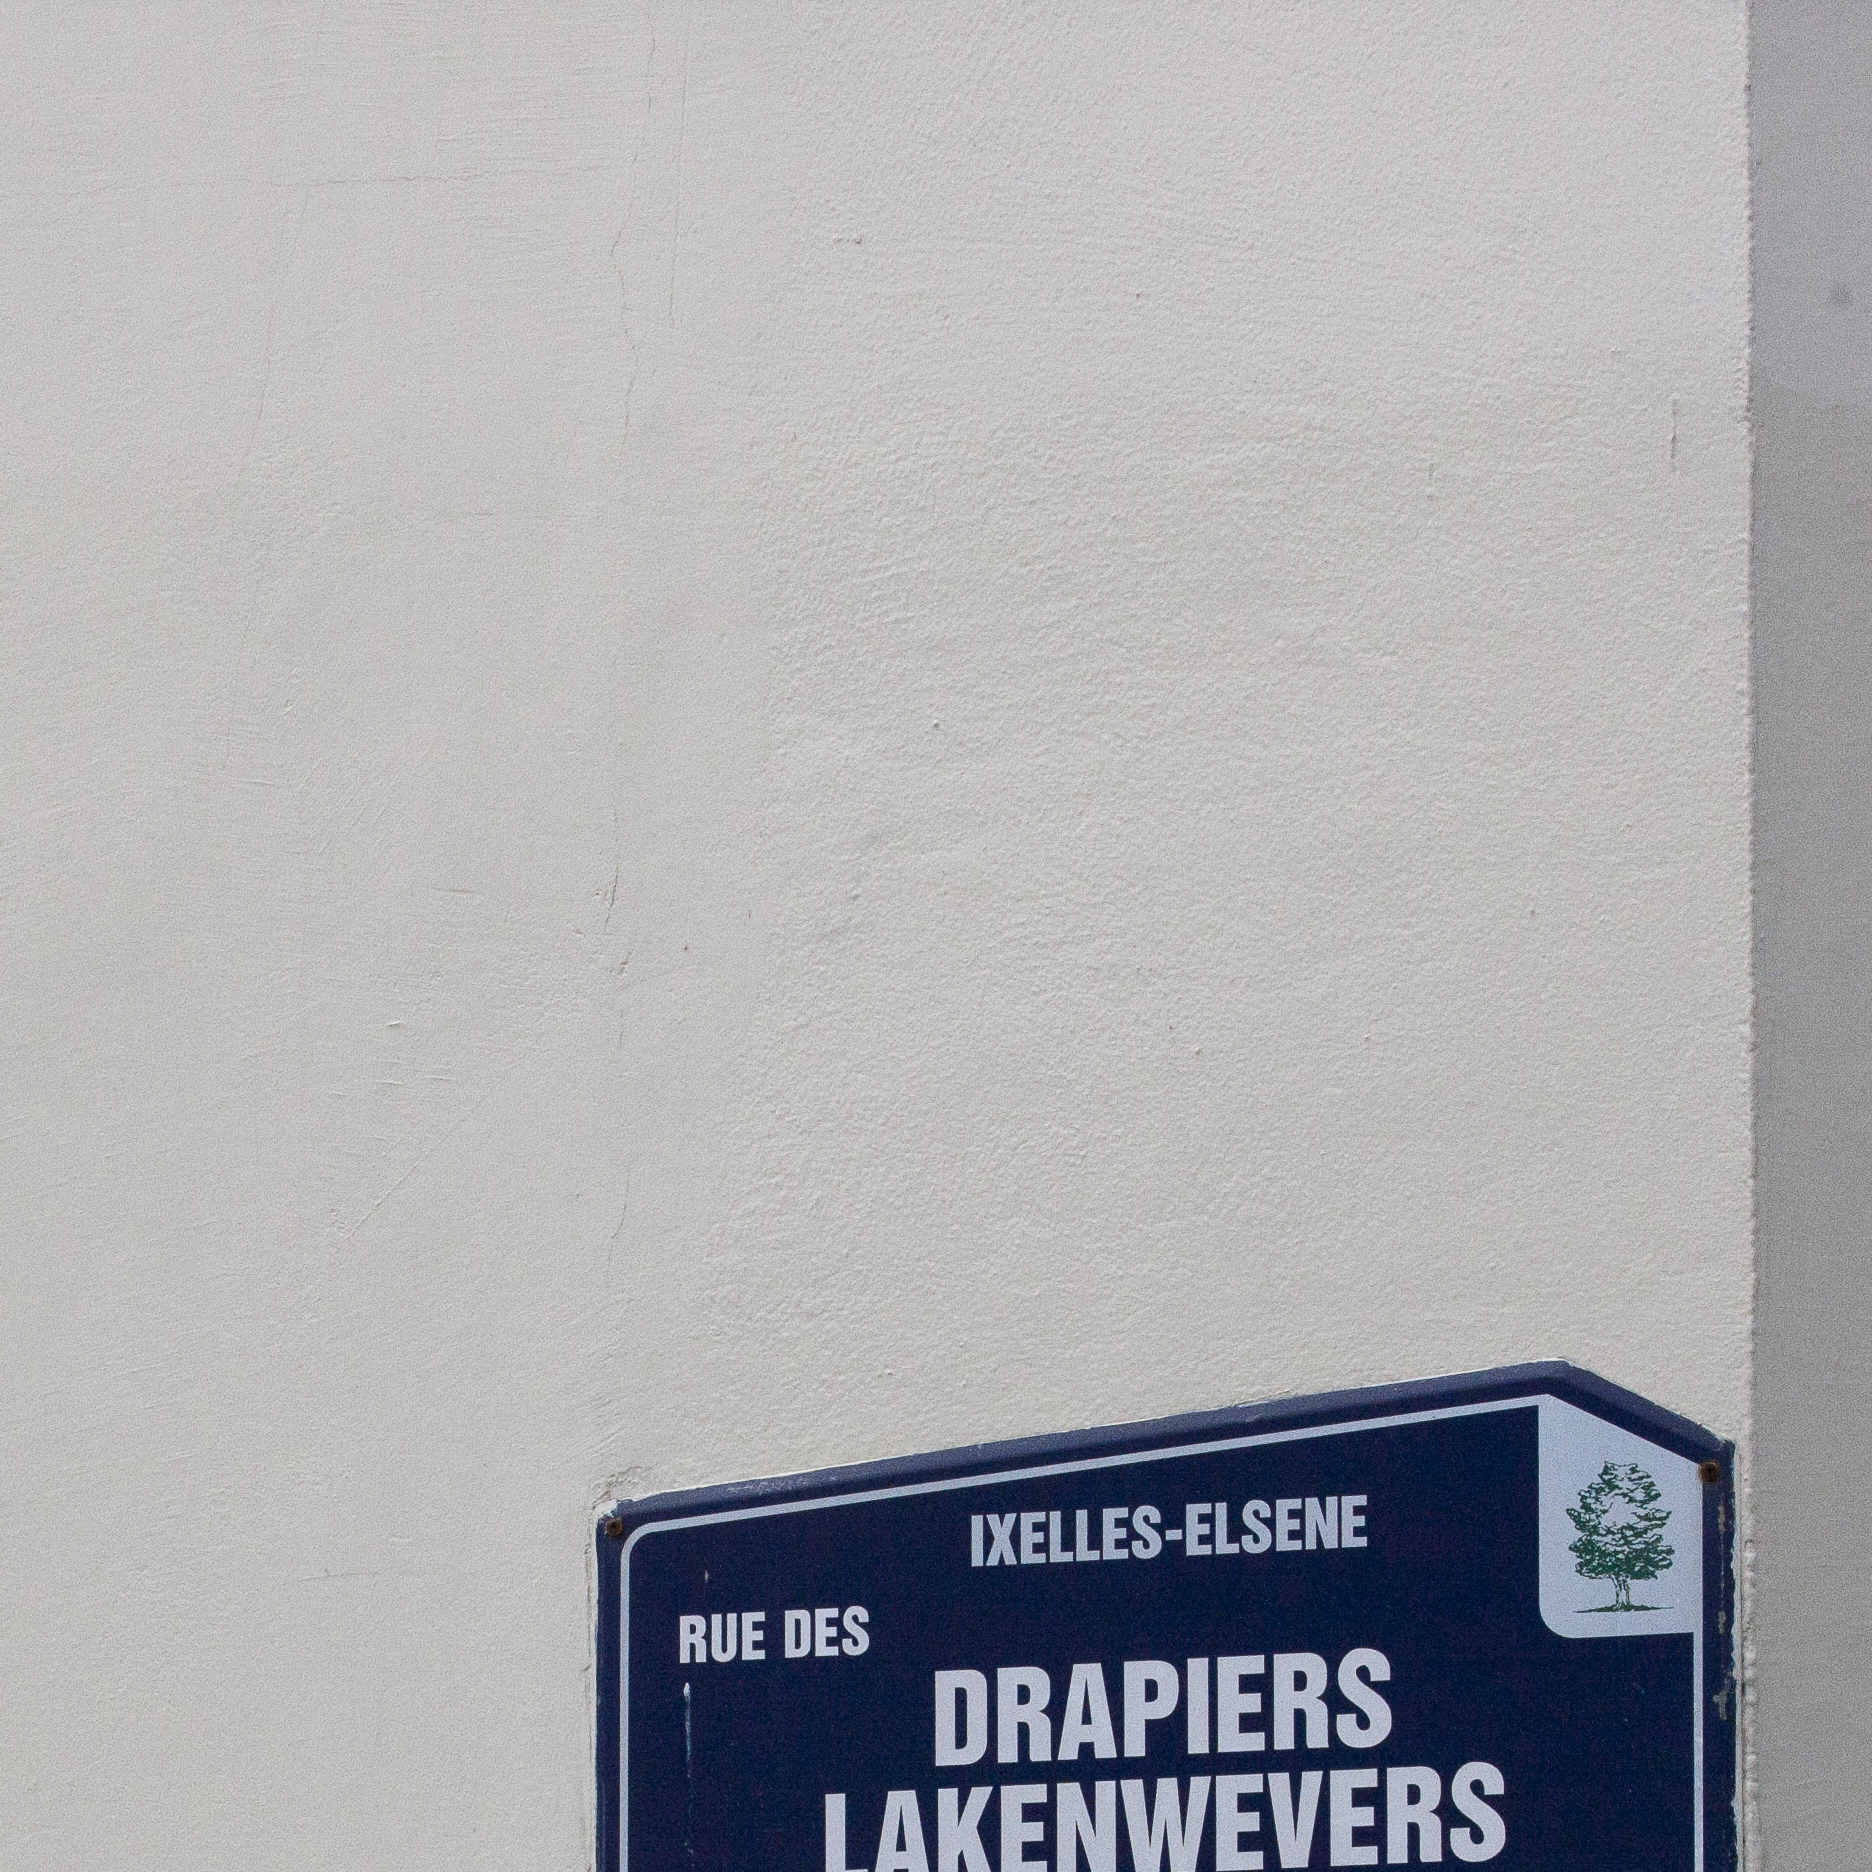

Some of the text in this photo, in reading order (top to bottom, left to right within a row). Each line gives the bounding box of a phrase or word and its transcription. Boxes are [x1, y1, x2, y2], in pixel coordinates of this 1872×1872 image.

[970, 1494, 1368, 1568] IXELLES-ELSENE
[679, 1605, 871, 1665] RUE DES
[935, 1648, 1392, 1767] DRAPIERS
